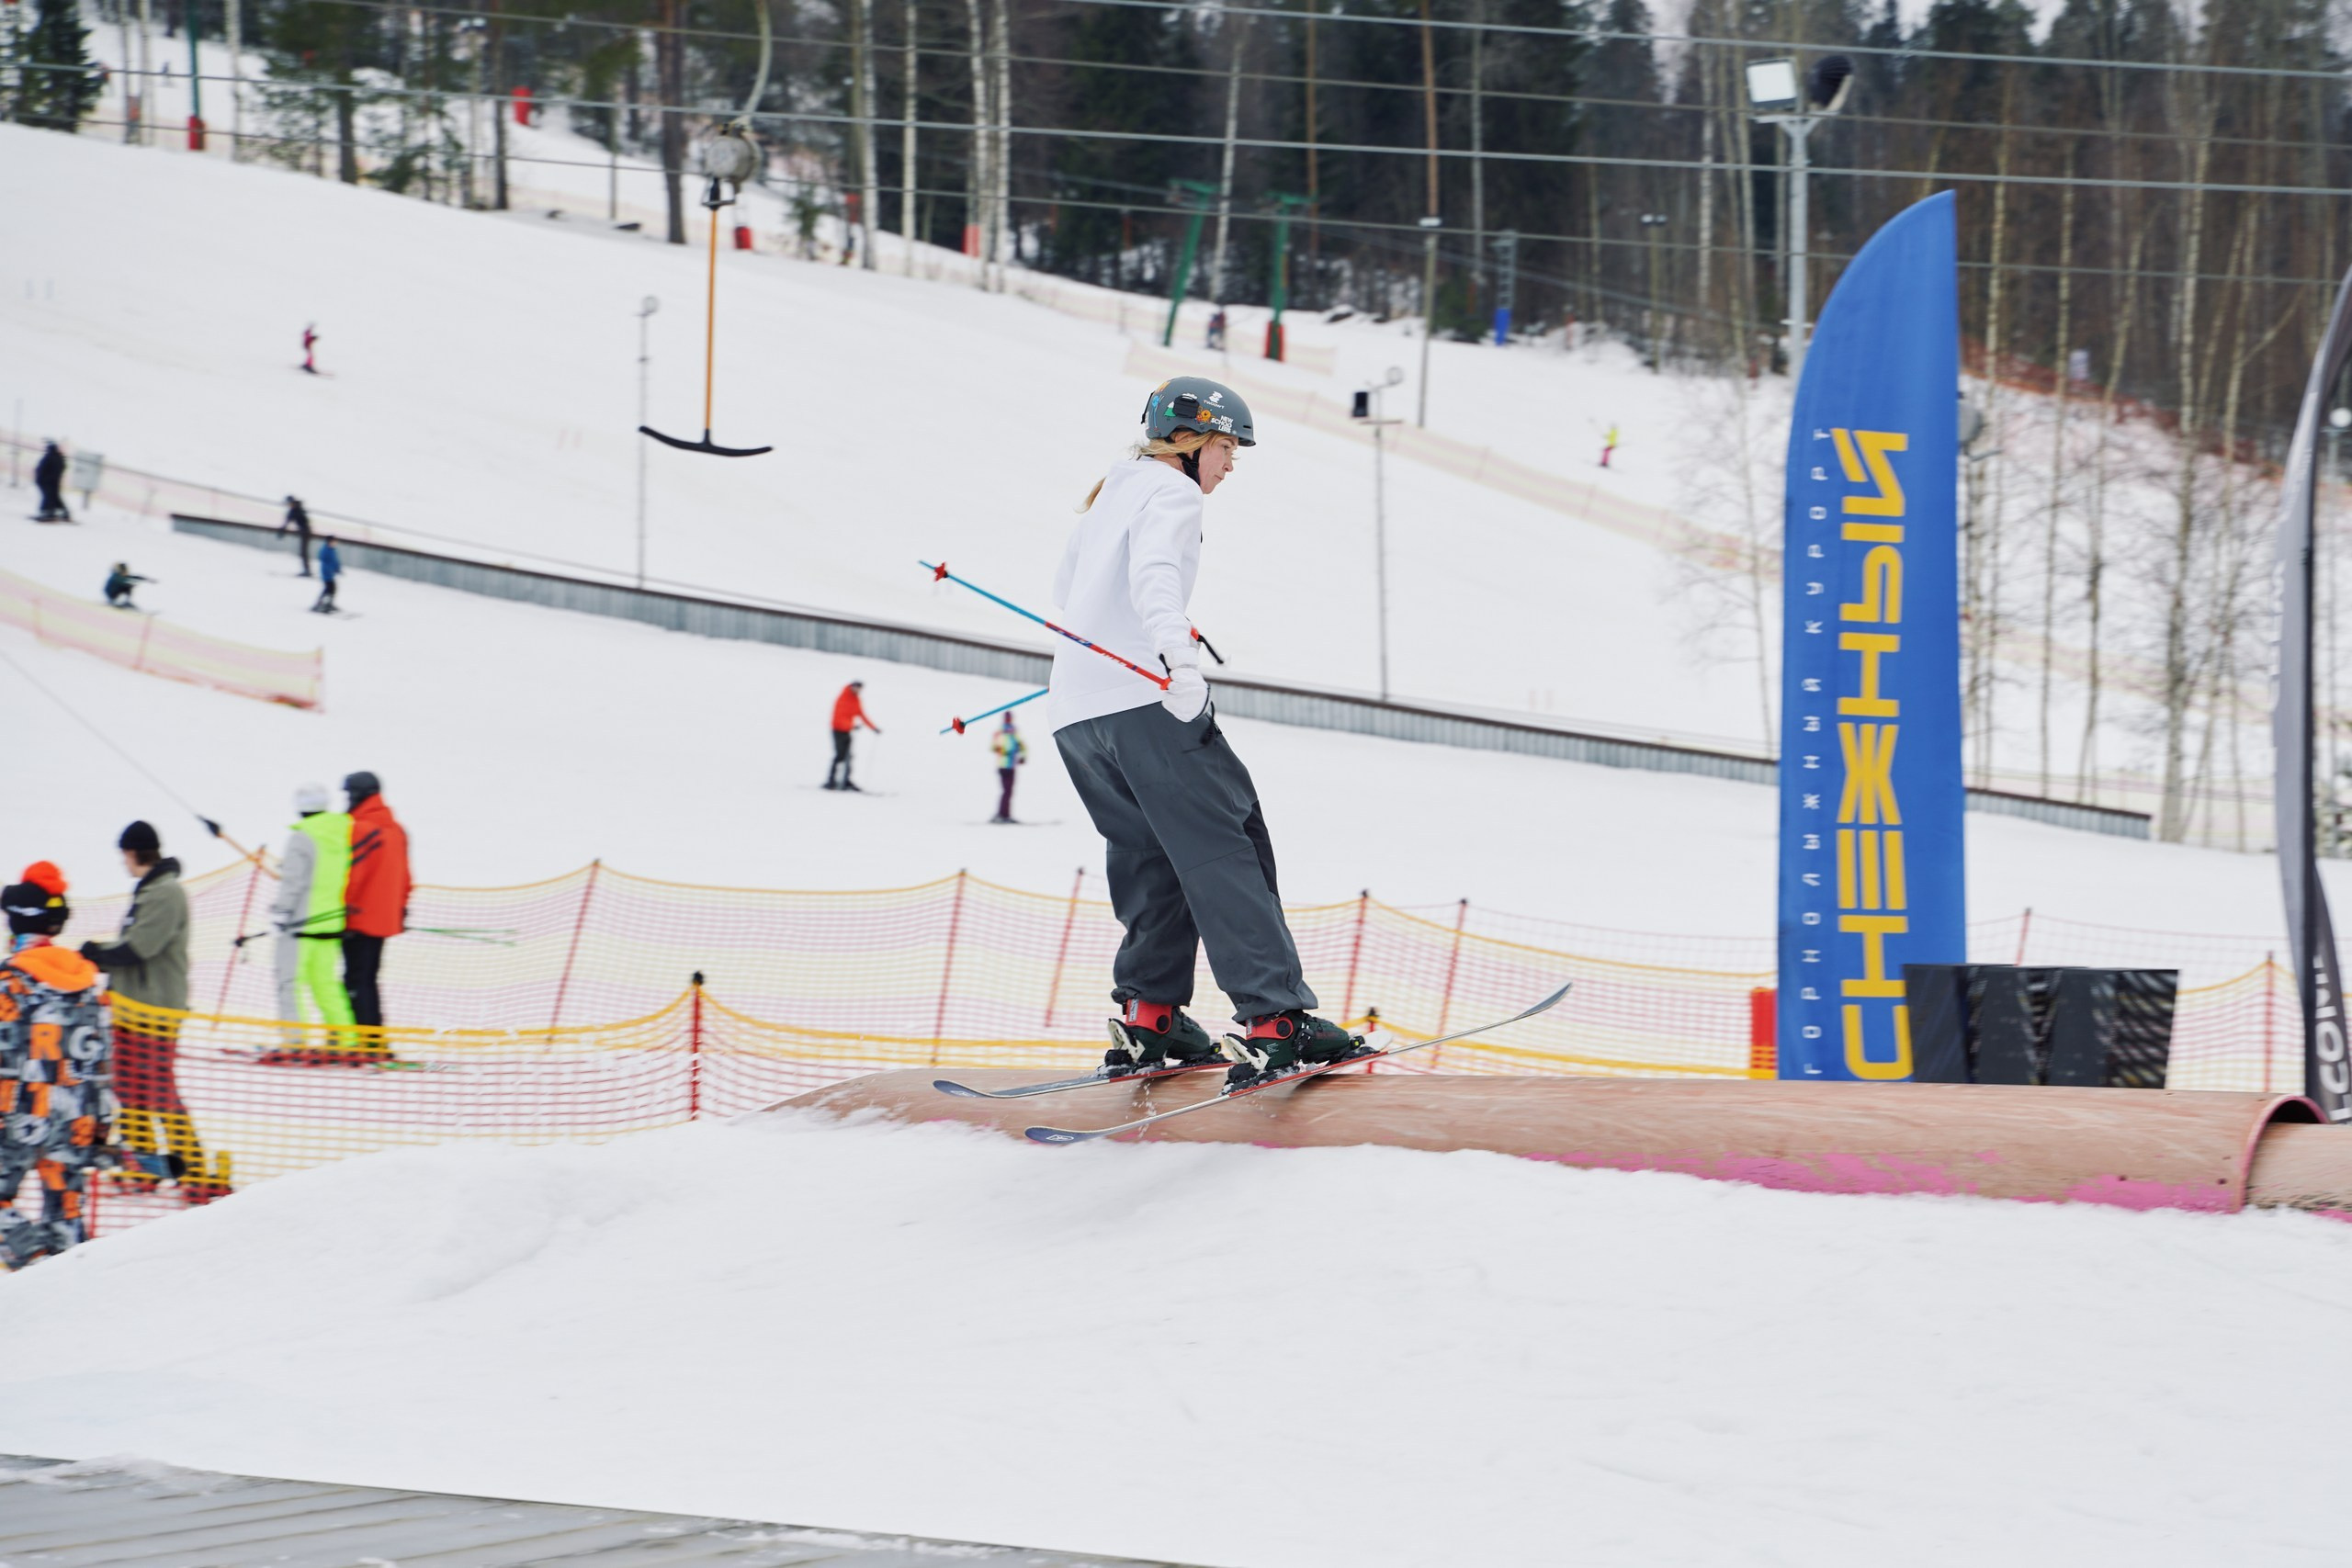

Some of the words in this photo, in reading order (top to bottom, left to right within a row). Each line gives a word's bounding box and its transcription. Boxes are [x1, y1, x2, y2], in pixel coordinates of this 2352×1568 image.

[1221, 415, 1233, 423] NEW
[1804, 428, 1831, 634] КУРОРТ
[1801, 677, 1823, 1075] ГОРНОЛЫЖНЫЙ
[1829, 427, 1914, 1080] СНЕЖНЫЙ
